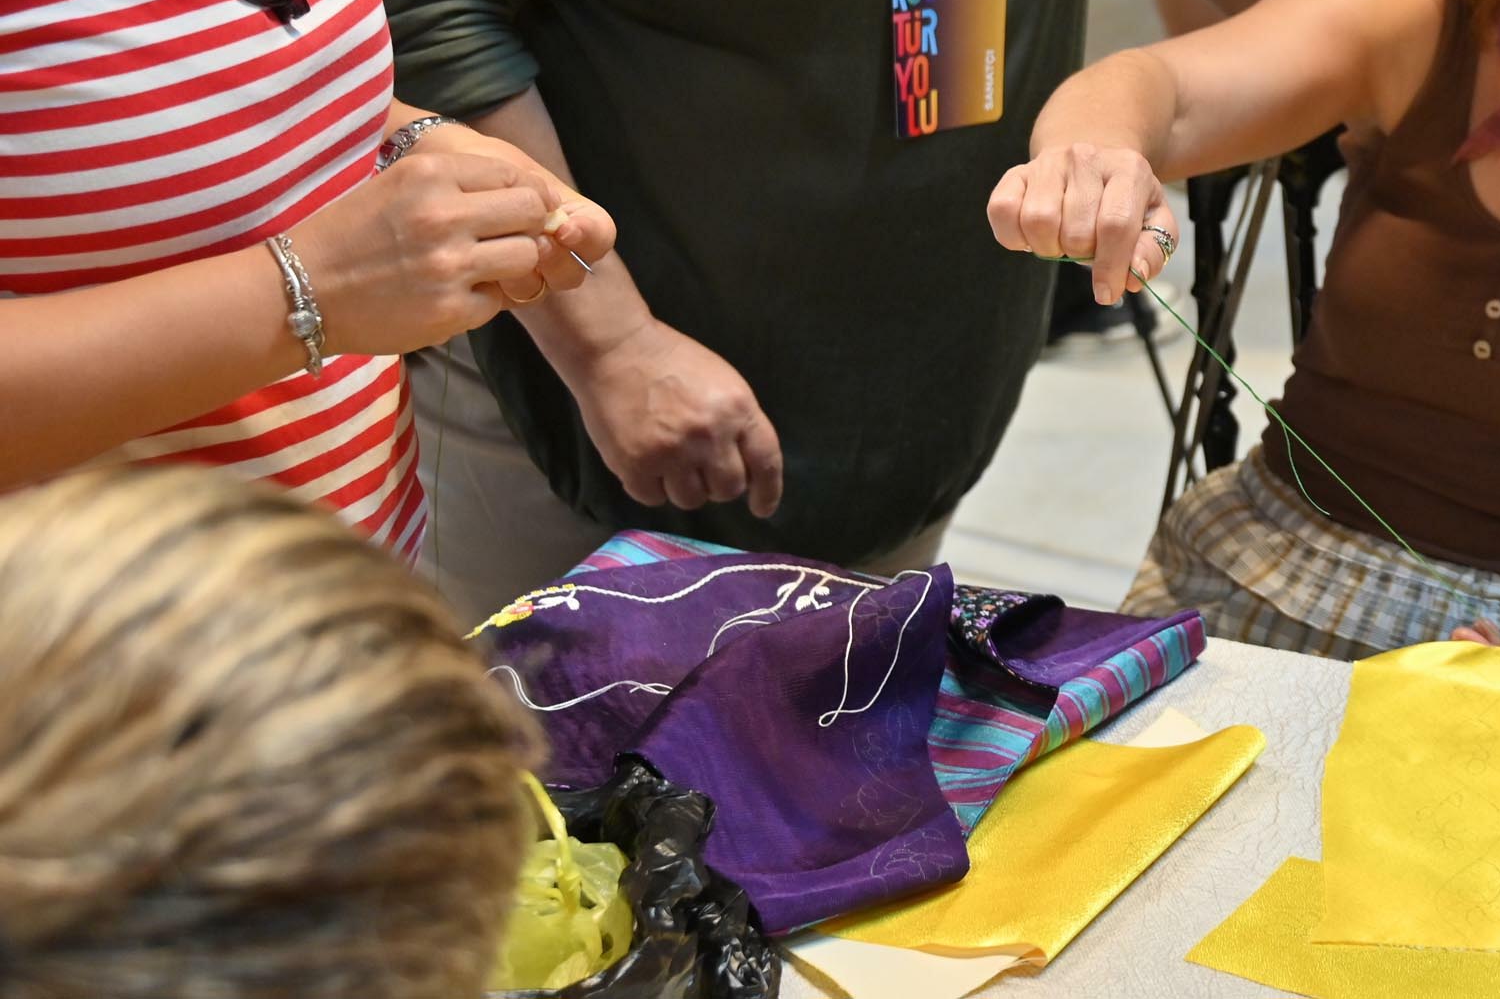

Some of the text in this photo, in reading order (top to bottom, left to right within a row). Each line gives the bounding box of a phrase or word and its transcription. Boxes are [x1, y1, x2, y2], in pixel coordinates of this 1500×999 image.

[893, 8, 938, 57] TÜR
[895, 54, 929, 102] YO
[907, 88, 939, 137] LU
